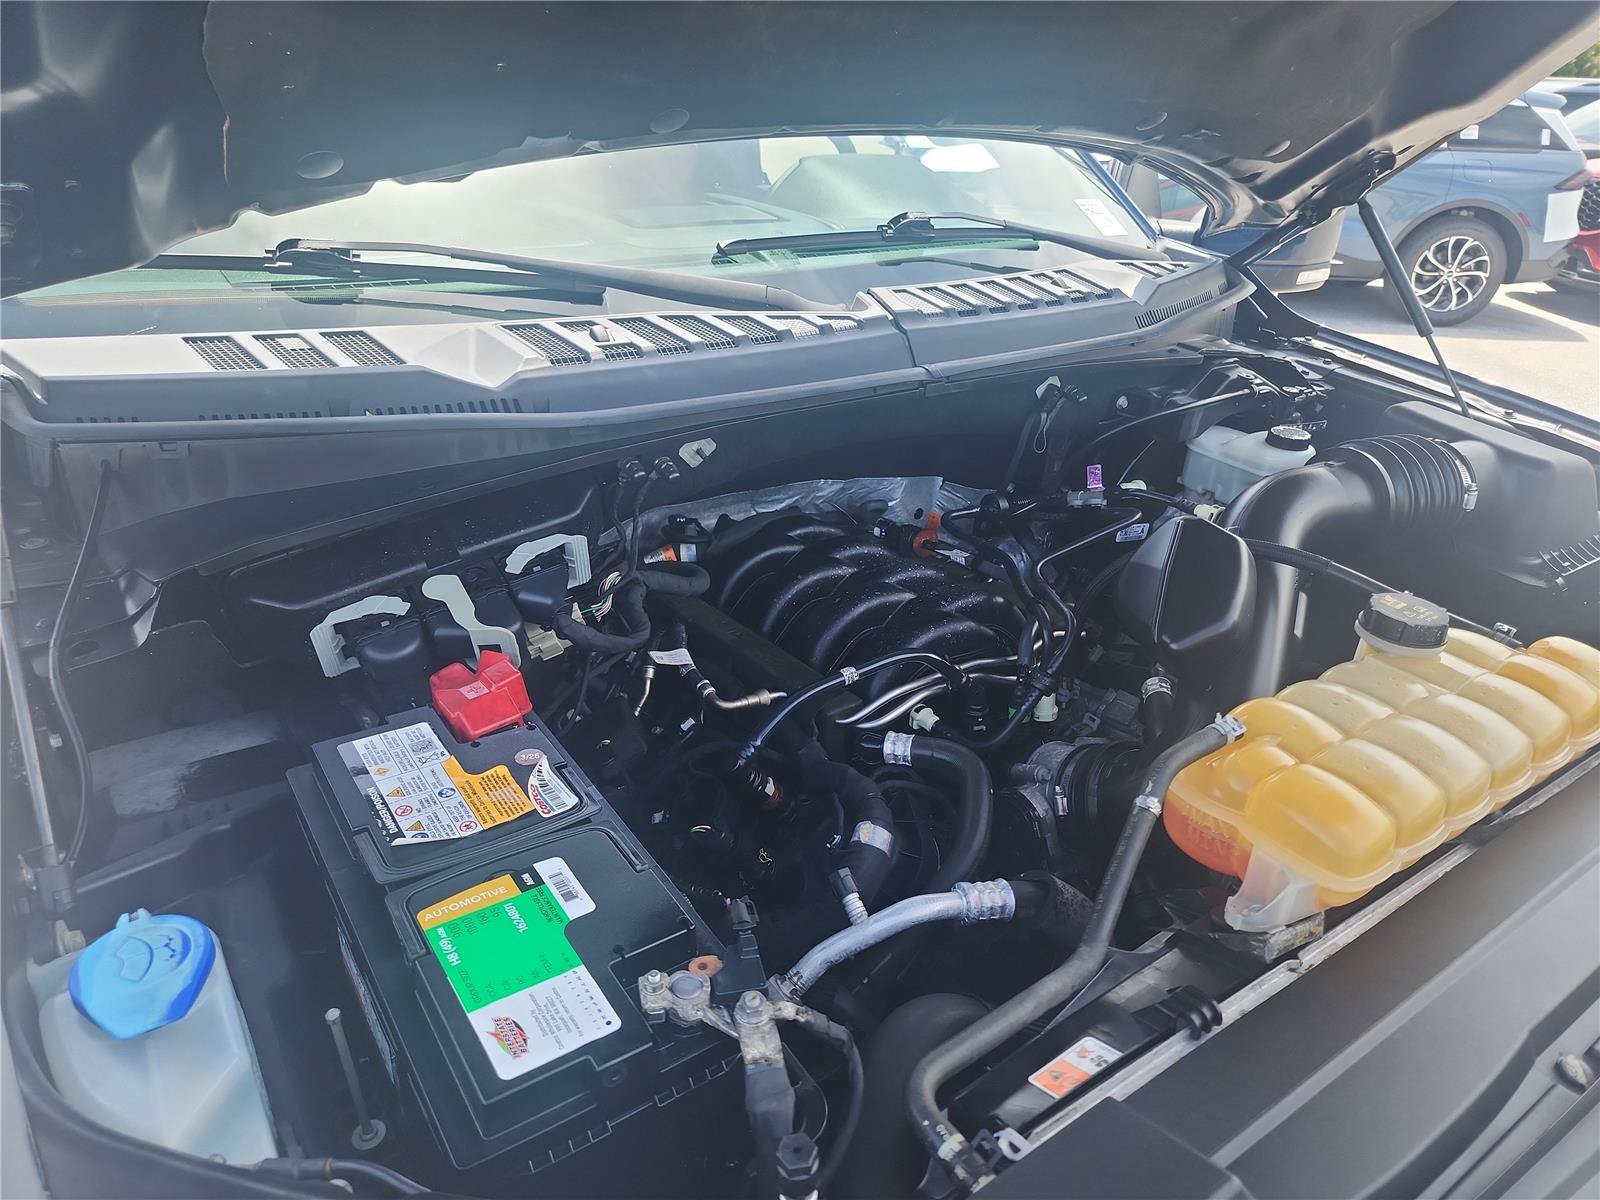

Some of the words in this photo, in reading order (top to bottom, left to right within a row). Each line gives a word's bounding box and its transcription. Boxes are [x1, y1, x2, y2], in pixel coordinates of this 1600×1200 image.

[520, 872, 534, 886] AGM
[424, 886, 508, 922] AUTOMOTIVE
[489, 905, 502, 918] 95
[462, 916, 478, 935] 1000
[476, 910, 490, 925] 160
[502, 901, 529, 933] 1624801
[435, 926, 447, 939] AGM
[446, 921, 463, 938] 900
[437, 936, 457, 954] (49)
[446, 951, 461, 966] H8
[494, 1017, 521, 1059] INTERSTATE
[503, 1016, 527, 1053] BATTERIES
